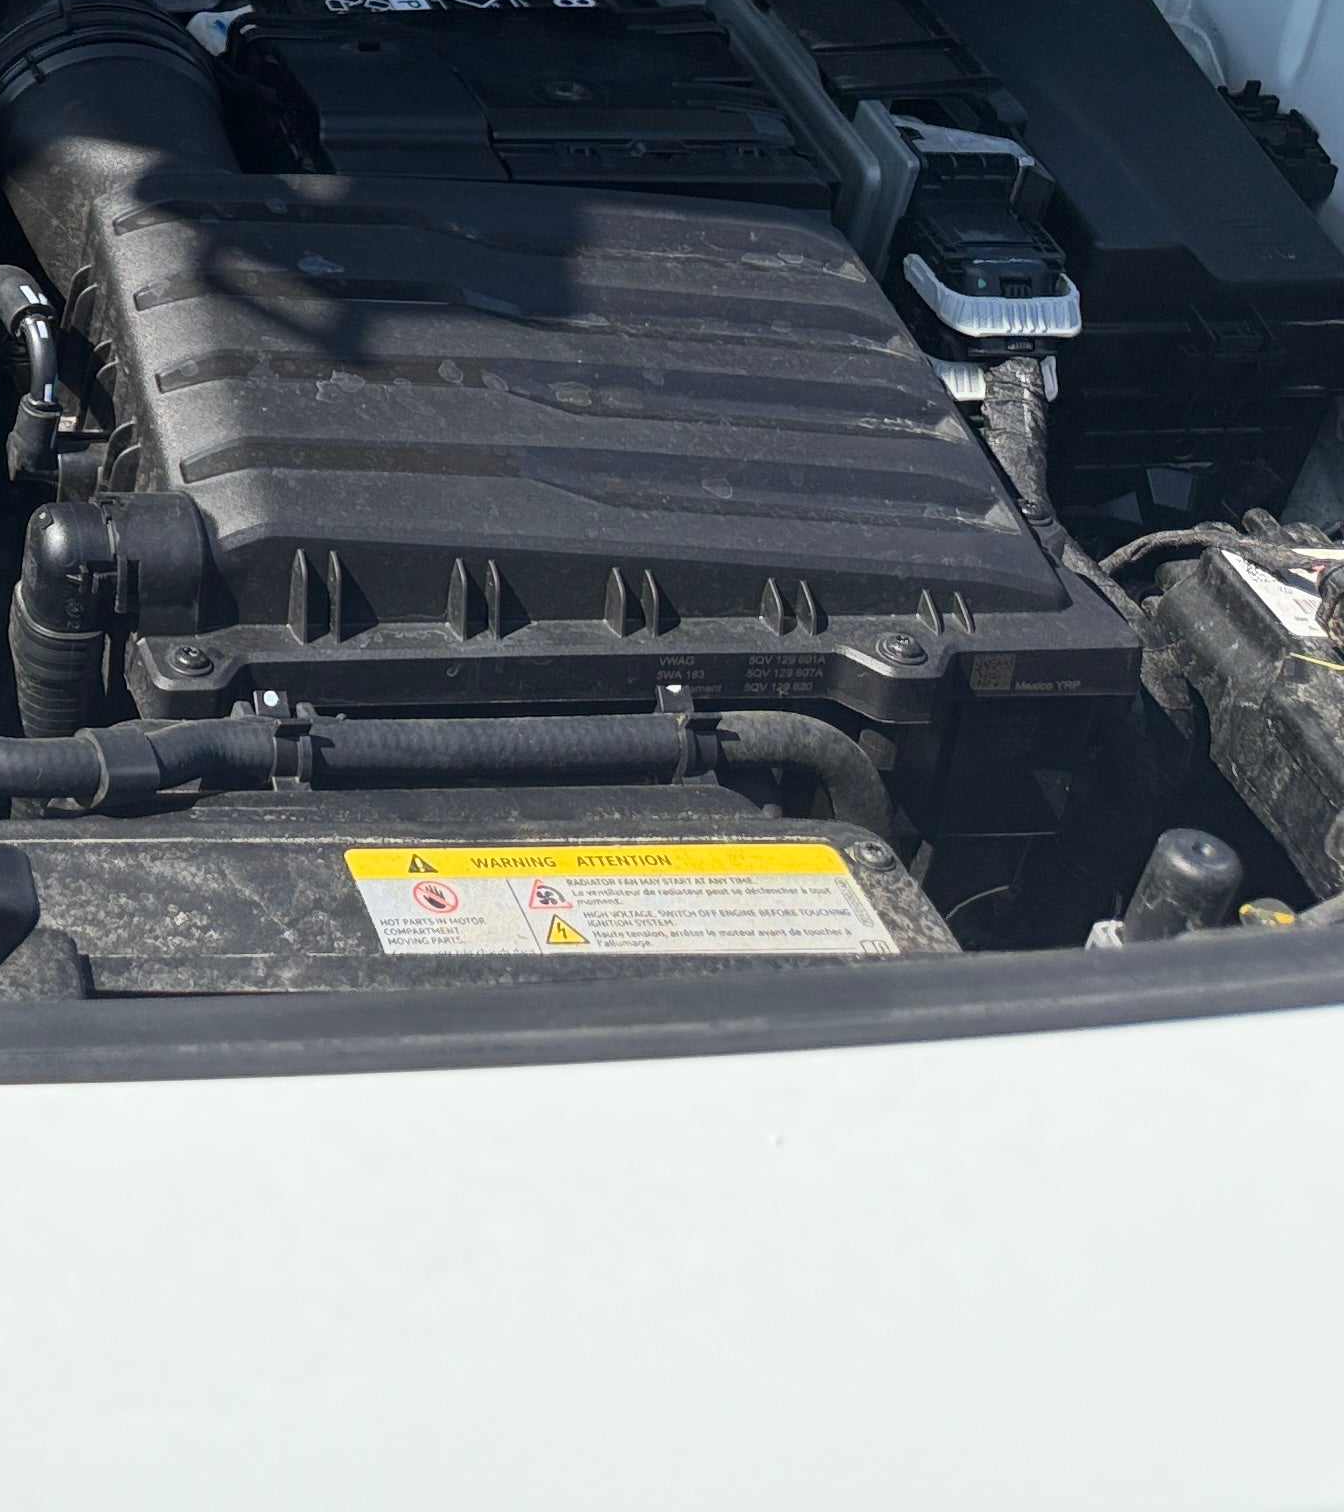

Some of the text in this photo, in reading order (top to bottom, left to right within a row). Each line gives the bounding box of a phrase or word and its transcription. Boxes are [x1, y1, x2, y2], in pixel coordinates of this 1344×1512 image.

[469, 856, 557, 868] WARNING
[576, 855, 672, 867] ATTENTION
[565, 877, 616, 886] RADIATOR
[618, 877, 638, 886] FAN
[640, 877, 660, 886] MAY
[662, 877, 693, 886] START
[694, 877, 706, 885] AT
[708, 877, 728, 885] ANY
[643, 888, 656, 896] de
[583, 908, 852, 919] HIGH SWITCH OFF ENGINE BEFORE TOUCHING
[380, 917, 486, 927] HOT PARTS IN MOTOR
[587, 919, 634, 928] IGNITION
[592, 930, 624, 939] Haute
[387, 936, 429, 945] MOVING
